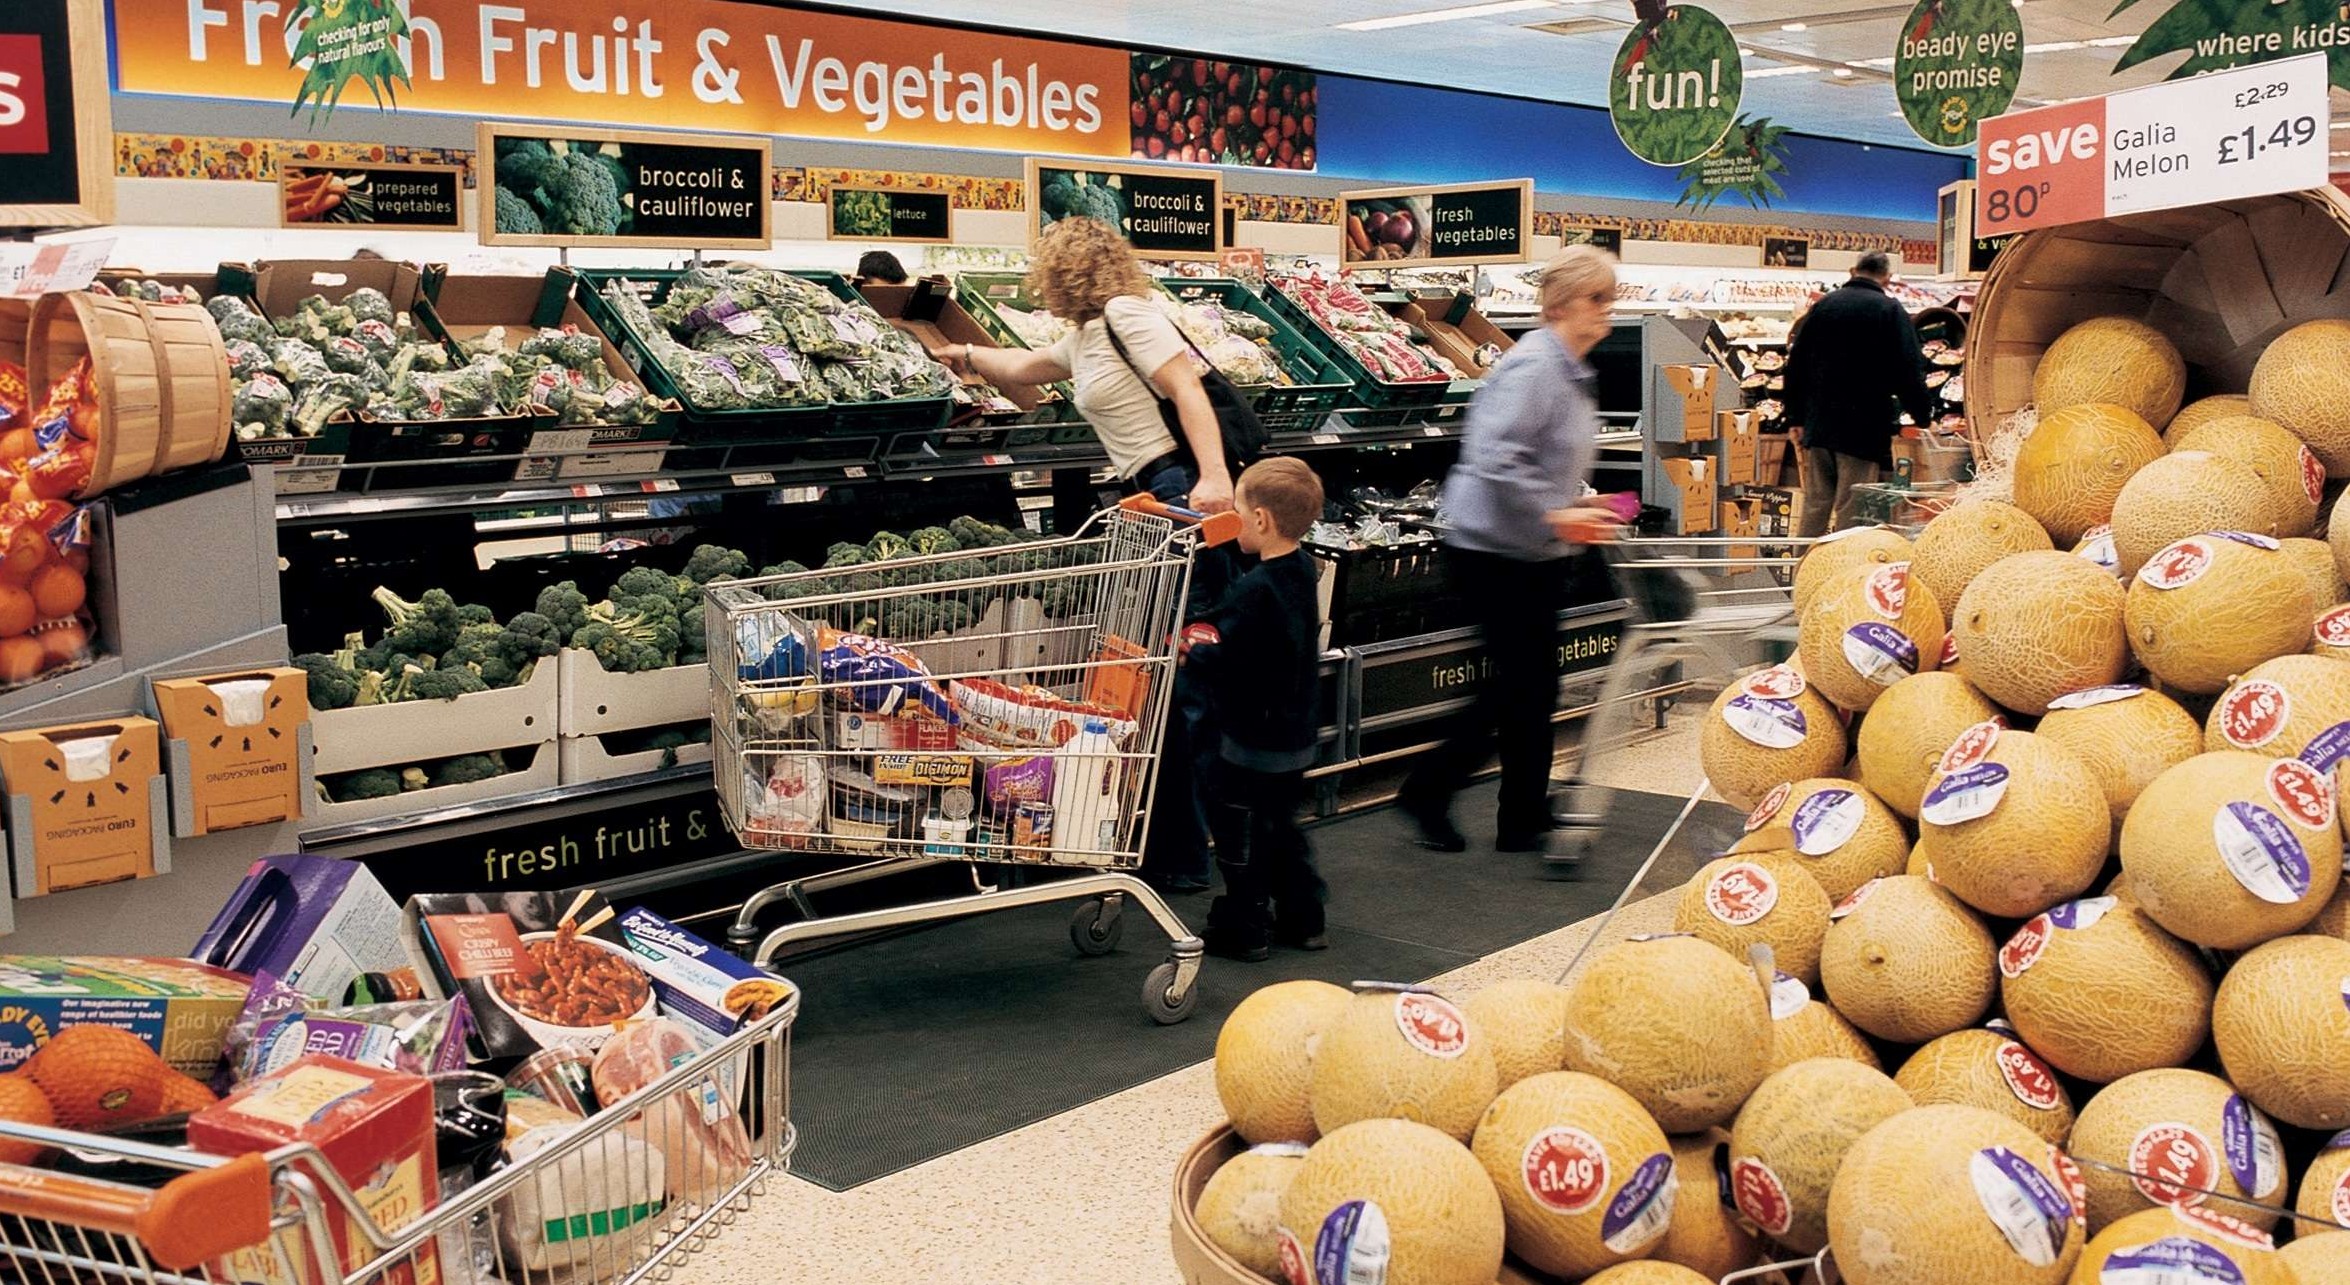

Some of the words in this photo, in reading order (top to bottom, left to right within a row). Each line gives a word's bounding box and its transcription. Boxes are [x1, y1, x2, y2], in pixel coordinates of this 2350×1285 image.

[318, 26, 357, 46] checking
[358, 21, 372, 37] for
[372, 16, 391, 33] only
[2197, 33, 2283, 58] where
[2293, 22, 2350, 49] kids
[318, 43, 351, 65] natural
[351, 38, 386, 57] flavours
[1902, 33, 1969, 62] beady
[1976, 31, 2017, 55] eye
[479, 4, 663, 98] Fruit
[691, 28, 743, 105] &
[765, 34, 1102, 133] Vegetables
[1913, 65, 2001, 96] promise
[1627, 57, 1721, 112] fun!
[2235, 81, 2289, 109] £2.29
[1987, 123, 2099, 175] save
[2113, 122, 2176, 151] Galia
[2218, 115, 2316, 165] £1.49
[640, 166, 724, 190] broccoli
[730, 169, 744, 189] &
[2113, 153, 2189, 181] Melon
[377, 182, 439, 199] prepared
[1134, 190, 1191, 212] broccoli
[1194, 195, 1205, 212] &
[377, 198, 452, 214] vegetables
[639, 196, 754, 219] cauliflower
[893, 208, 927, 220] lettuce
[1435, 206, 1473, 223] fresh
[1134, 215, 1210, 236] cauliflower
[1435, 224, 1517, 246] vegetables
[1977, 238, 1989, 250] &
[1868, 627, 1897, 649] Galia
[1432, 659, 1475, 689] fresh
[1557, 634, 1618, 667] getables
[2234, 694, 2275, 737] £1.49
[262, 762, 287, 774] EURO
[880, 755, 913, 764] FREE
[914, 763, 968, 776] DIGIMON
[206, 768, 260, 783] PACKAGING
[2277, 771, 2323, 817] £1.49
[46, 824, 105, 841] PACKAGING
[107, 819, 136, 832] EURO
[485, 836, 580, 882] fresh
[596, 817, 671, 860] fruit
[687, 810, 707, 840] &
[175, 1011, 207, 1030] did
[213, 1015, 235, 1035] yo
[2011, 1052, 2052, 1092] £1.49
[2234, 1132, 2248, 1171] Galia
[1539, 1157, 1595, 1192] £1.49
[2159, 1137, 2200, 1196] £1.49
[1614, 1188, 1649, 1218] Galia
